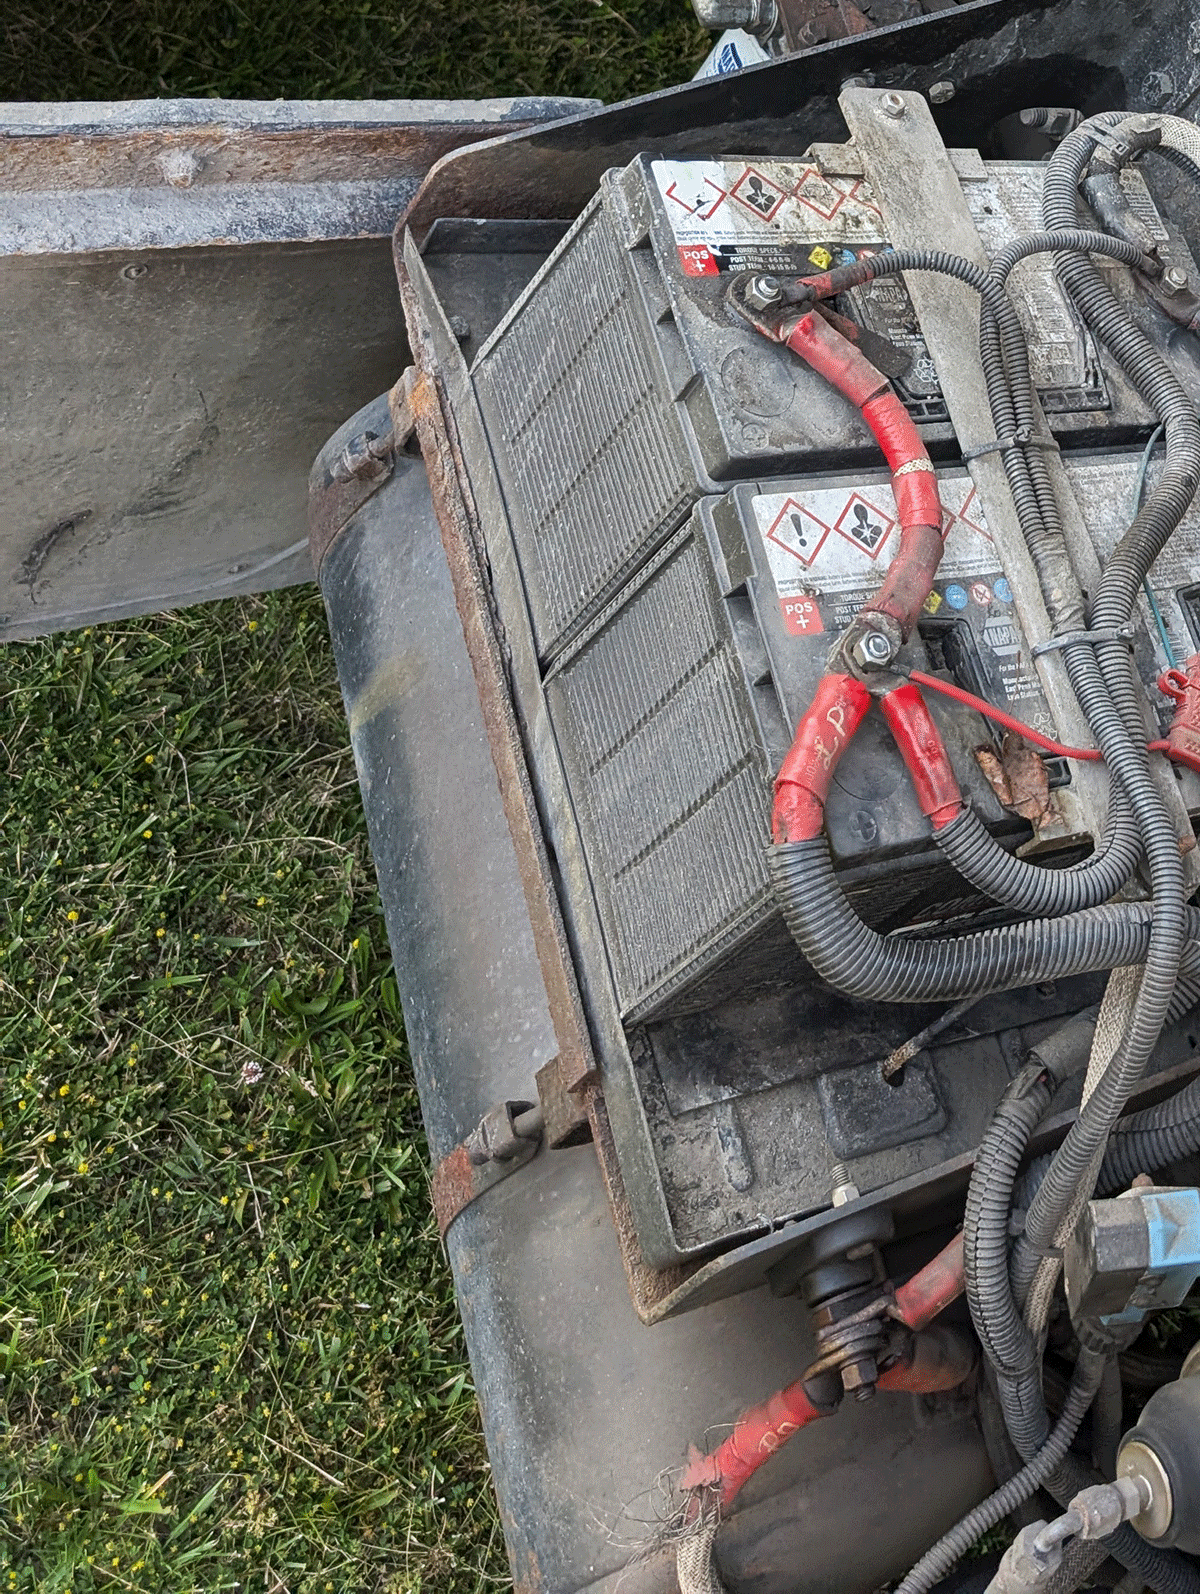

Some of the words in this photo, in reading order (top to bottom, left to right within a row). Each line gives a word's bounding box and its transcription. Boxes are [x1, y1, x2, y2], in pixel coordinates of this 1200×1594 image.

[683, 250, 710, 260] POS
[785, 601, 813, 615] POS
[835, 605, 853, 614] POST
[834, 614, 852, 624] STUD
[988, 625, 1017, 647] NAPA
